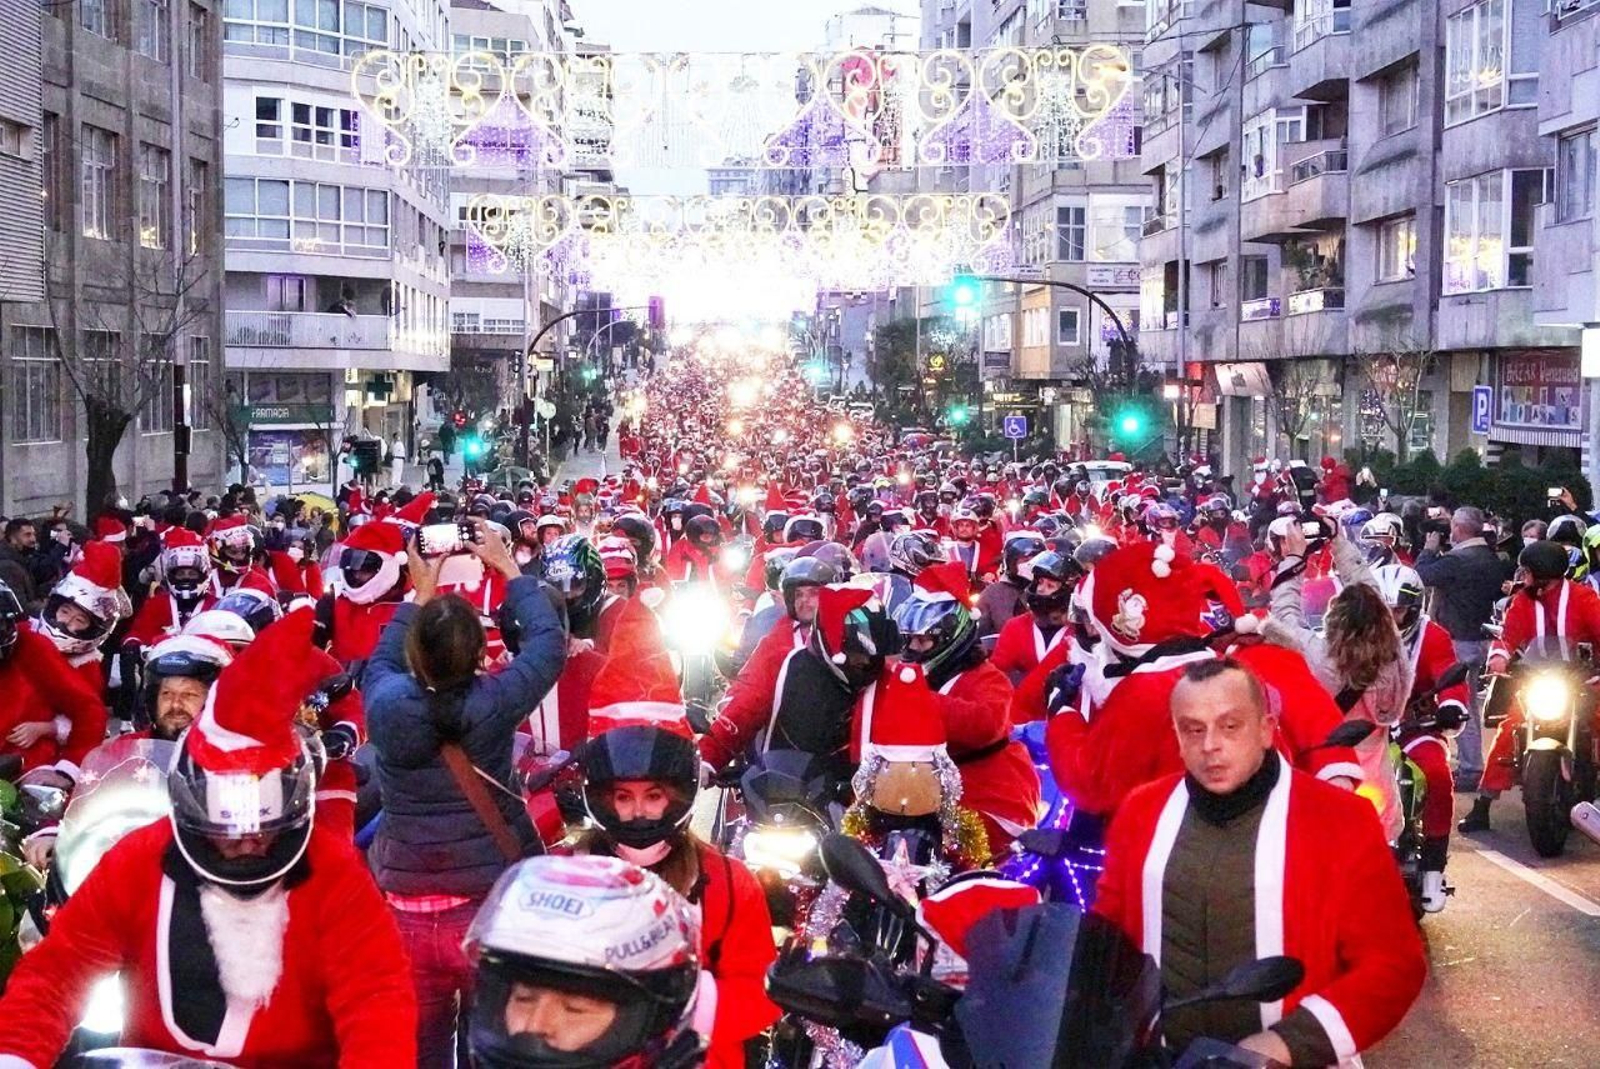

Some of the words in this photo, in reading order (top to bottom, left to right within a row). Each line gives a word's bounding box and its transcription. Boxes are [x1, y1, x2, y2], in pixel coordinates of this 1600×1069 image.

[1506, 363, 1536, 382] BAZAR
[1477, 392, 1488, 427] P
[527, 890, 585, 916] SHOEI
